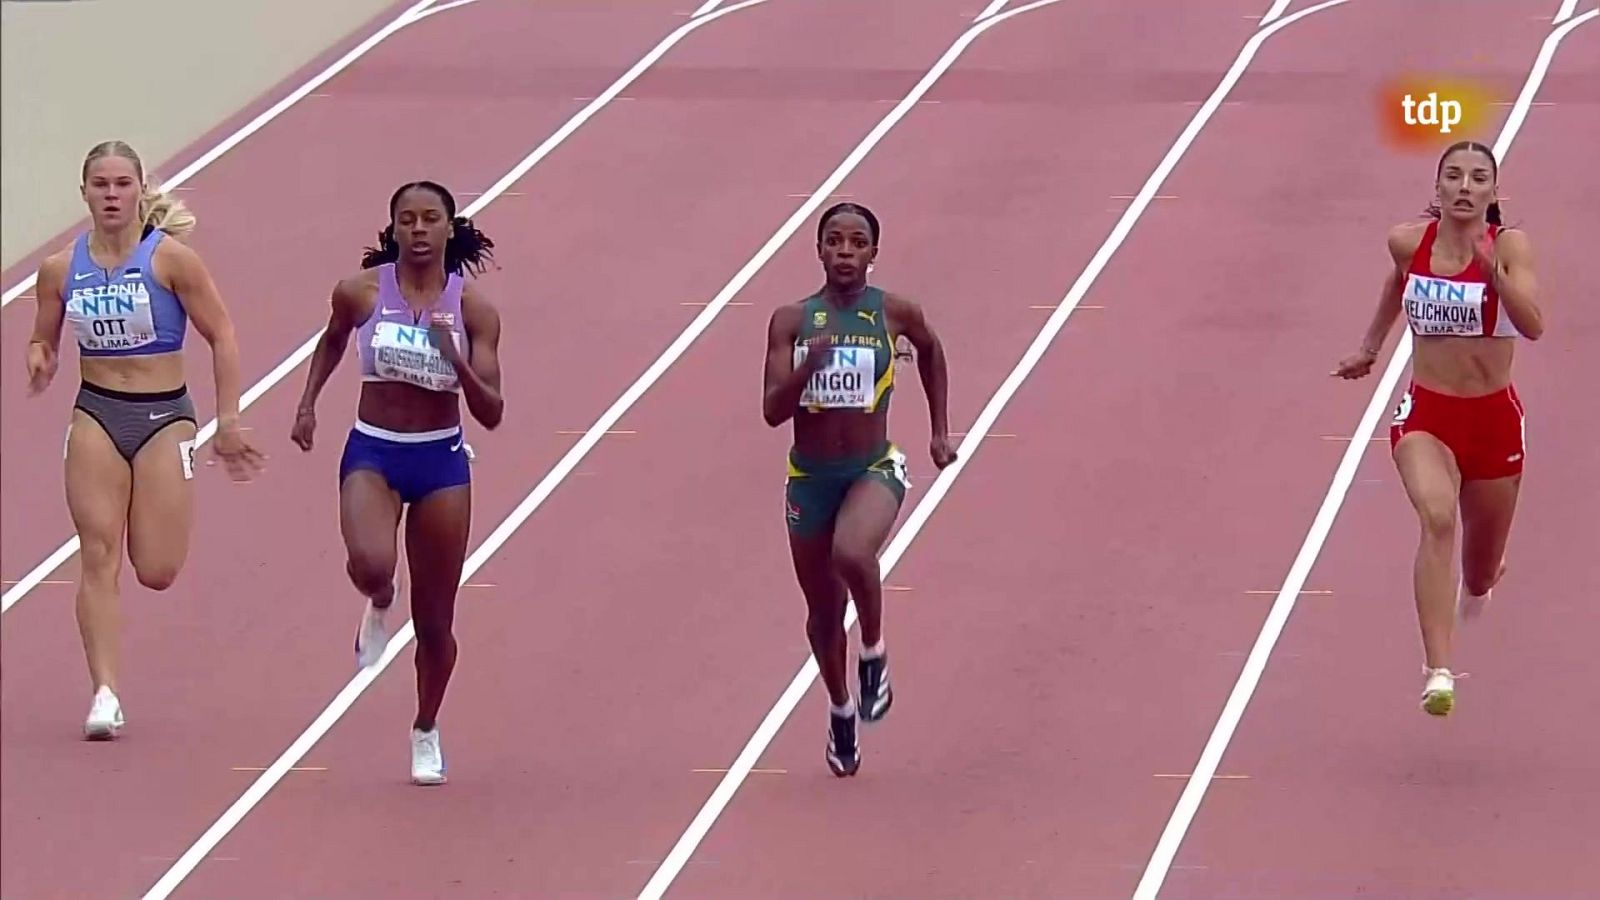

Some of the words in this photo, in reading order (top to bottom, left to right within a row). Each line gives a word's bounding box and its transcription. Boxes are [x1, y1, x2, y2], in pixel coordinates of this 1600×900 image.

[72, 282, 147, 299] ESTONIA
[1414, 278, 1466, 302] NTN
[82, 294, 135, 315] NTN
[92, 319, 126, 337] OTT
[397, 326, 429, 347] NT
[1424, 324, 1454, 334] LIMA
[101, 338, 130, 349] LIMA
[844, 334, 883, 348] AFRICA
[809, 372, 861, 391] INGQI
